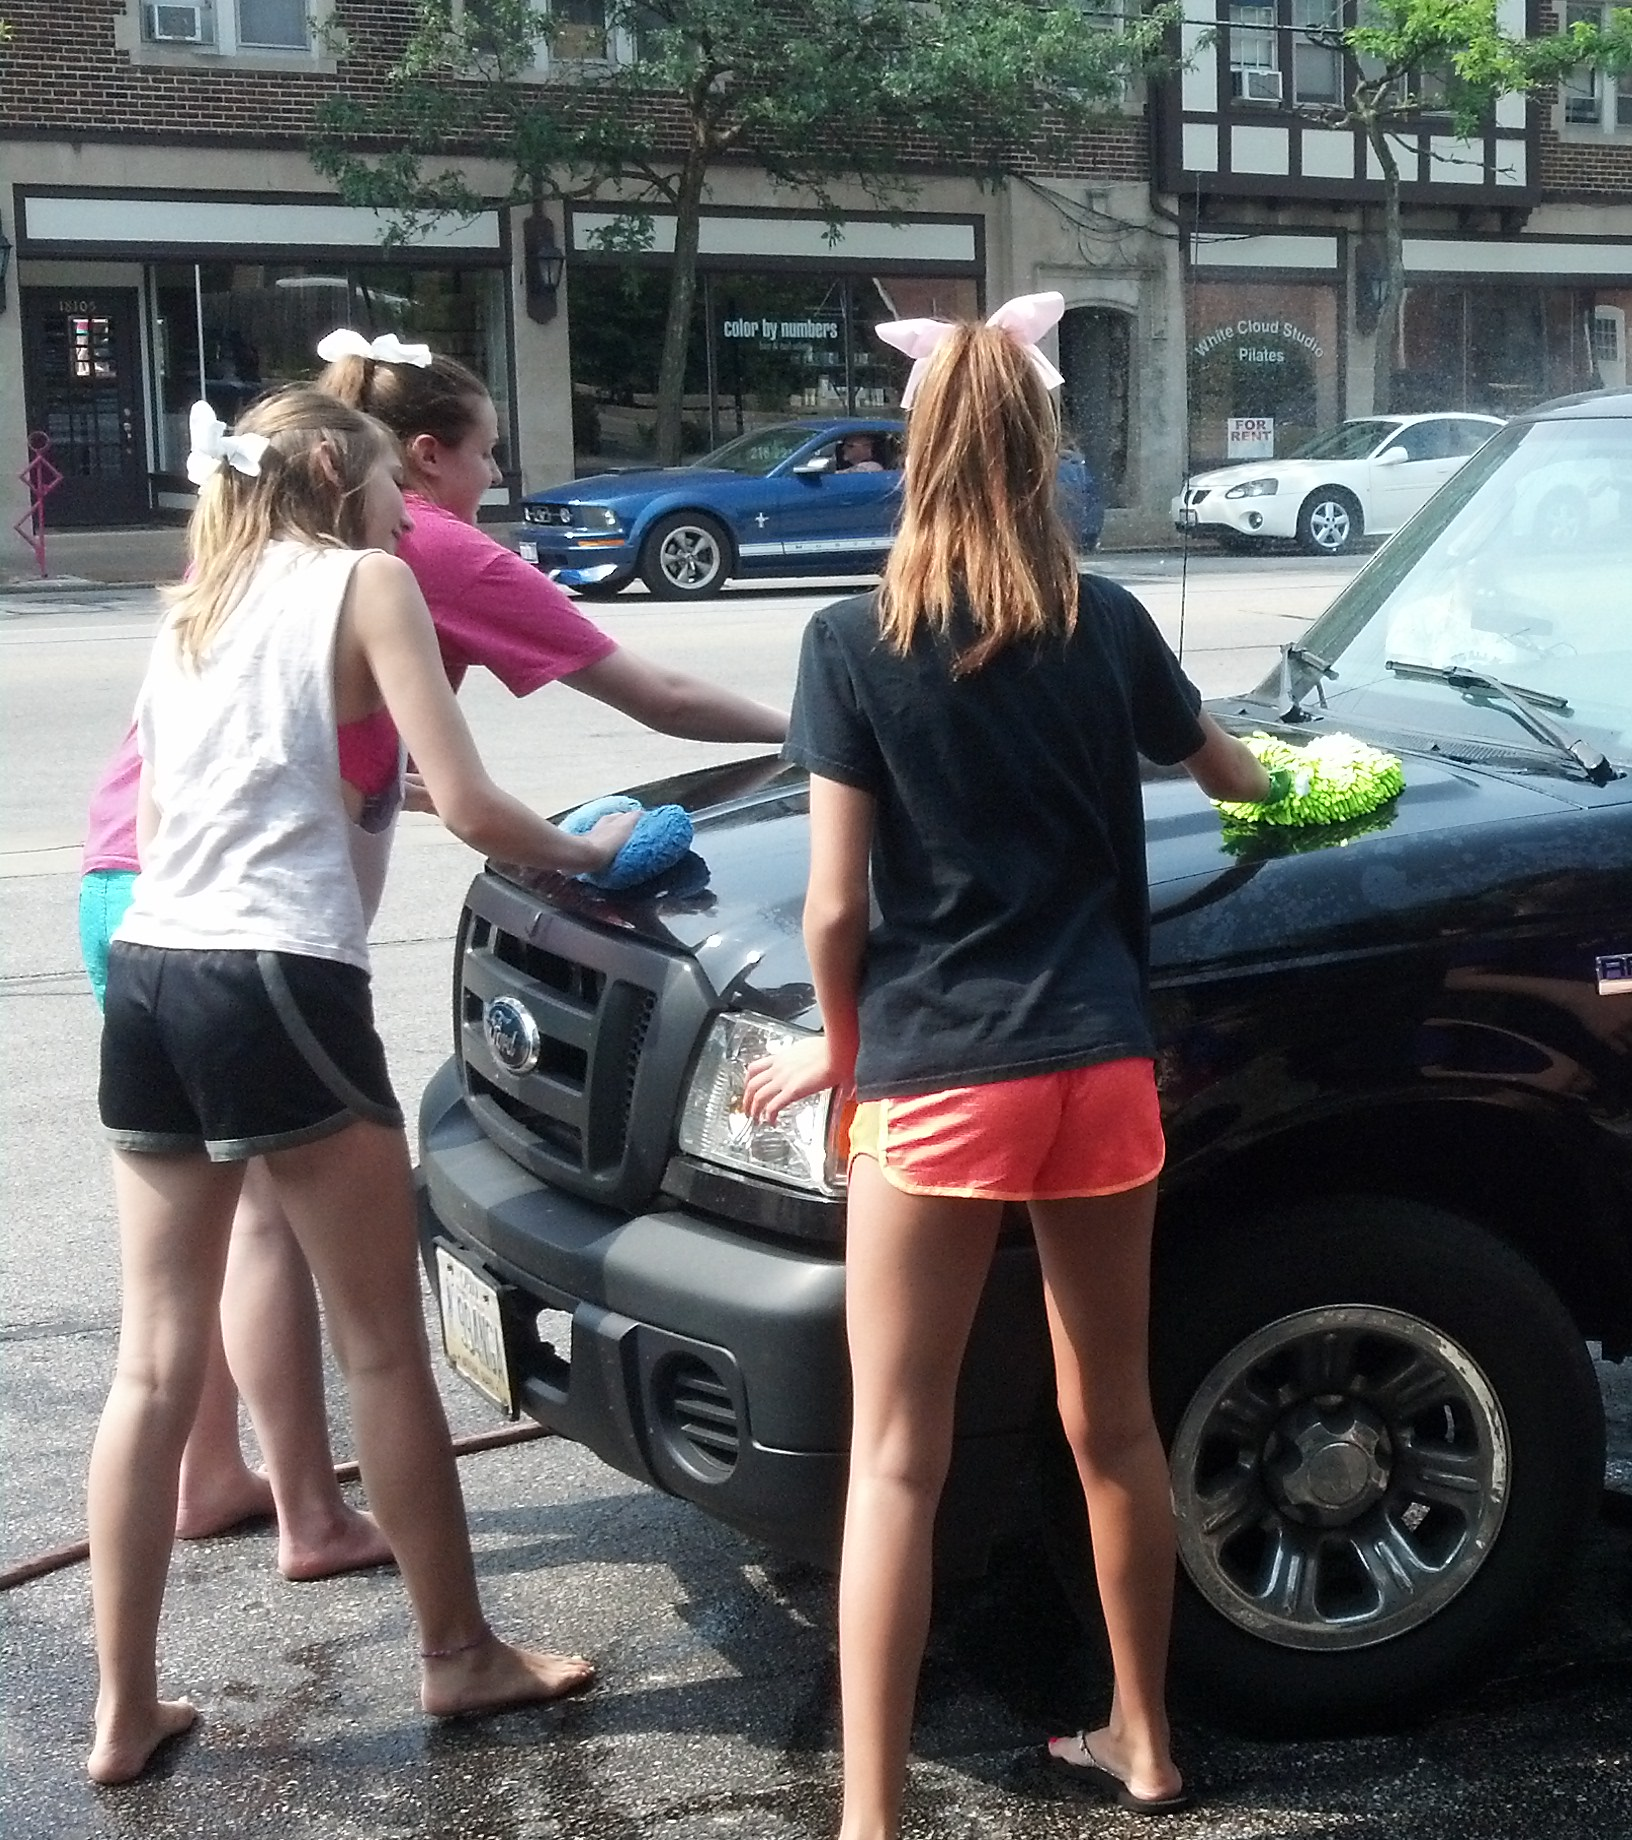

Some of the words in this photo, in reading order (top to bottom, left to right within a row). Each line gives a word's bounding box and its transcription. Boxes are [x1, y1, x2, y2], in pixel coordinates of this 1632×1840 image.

[724, 318, 758, 338] color
[762, 318, 778, 341] by
[781, 319, 838, 339] numbers
[1195, 326, 1235, 357] White
[1237, 320, 1279, 335] Cloud
[1283, 322, 1325, 358] Studio
[1239, 348, 1285, 362] Pilates
[1235, 420, 1267, 431] FOR
[1231, 431, 1272, 442] RENT
